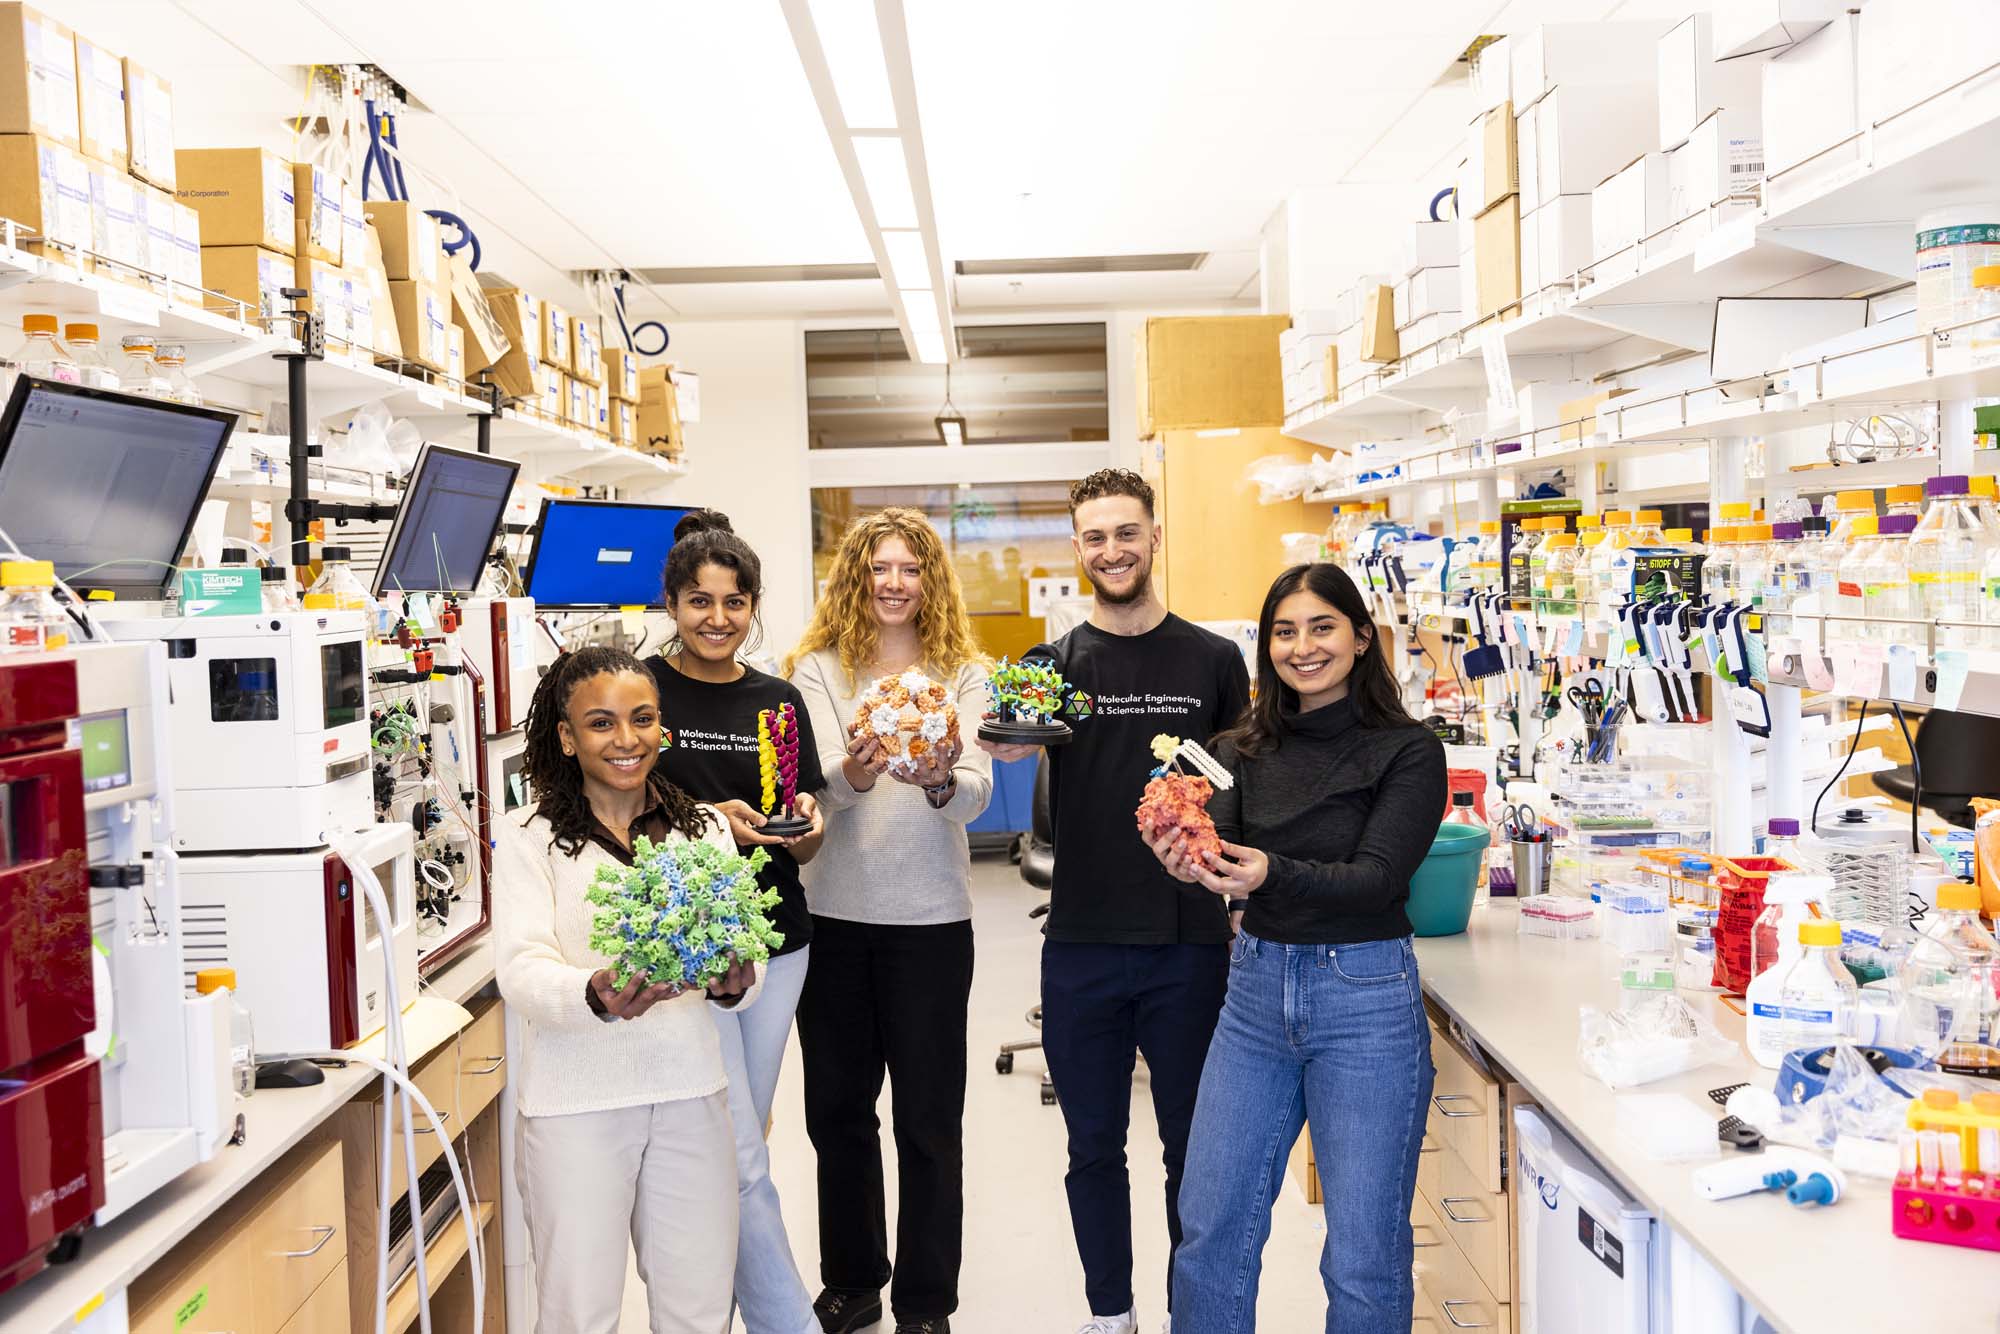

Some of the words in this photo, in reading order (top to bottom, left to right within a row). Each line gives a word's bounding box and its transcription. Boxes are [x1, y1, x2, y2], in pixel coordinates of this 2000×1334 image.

[190, 189, 230, 199] Corporation
[202, 575, 243, 585] KIMTECH
[1097, 693, 1142, 704] Molecular
[1145, 693, 1202, 707] Engineering
[1097, 706, 1104, 715] &
[1106, 706, 1145, 715] Sciences
[1147, 705, 1189, 714] Institute
[679, 729, 727, 741] Molecular
[680, 740, 689, 748] &
[690, 740, 732, 751] Sciences
